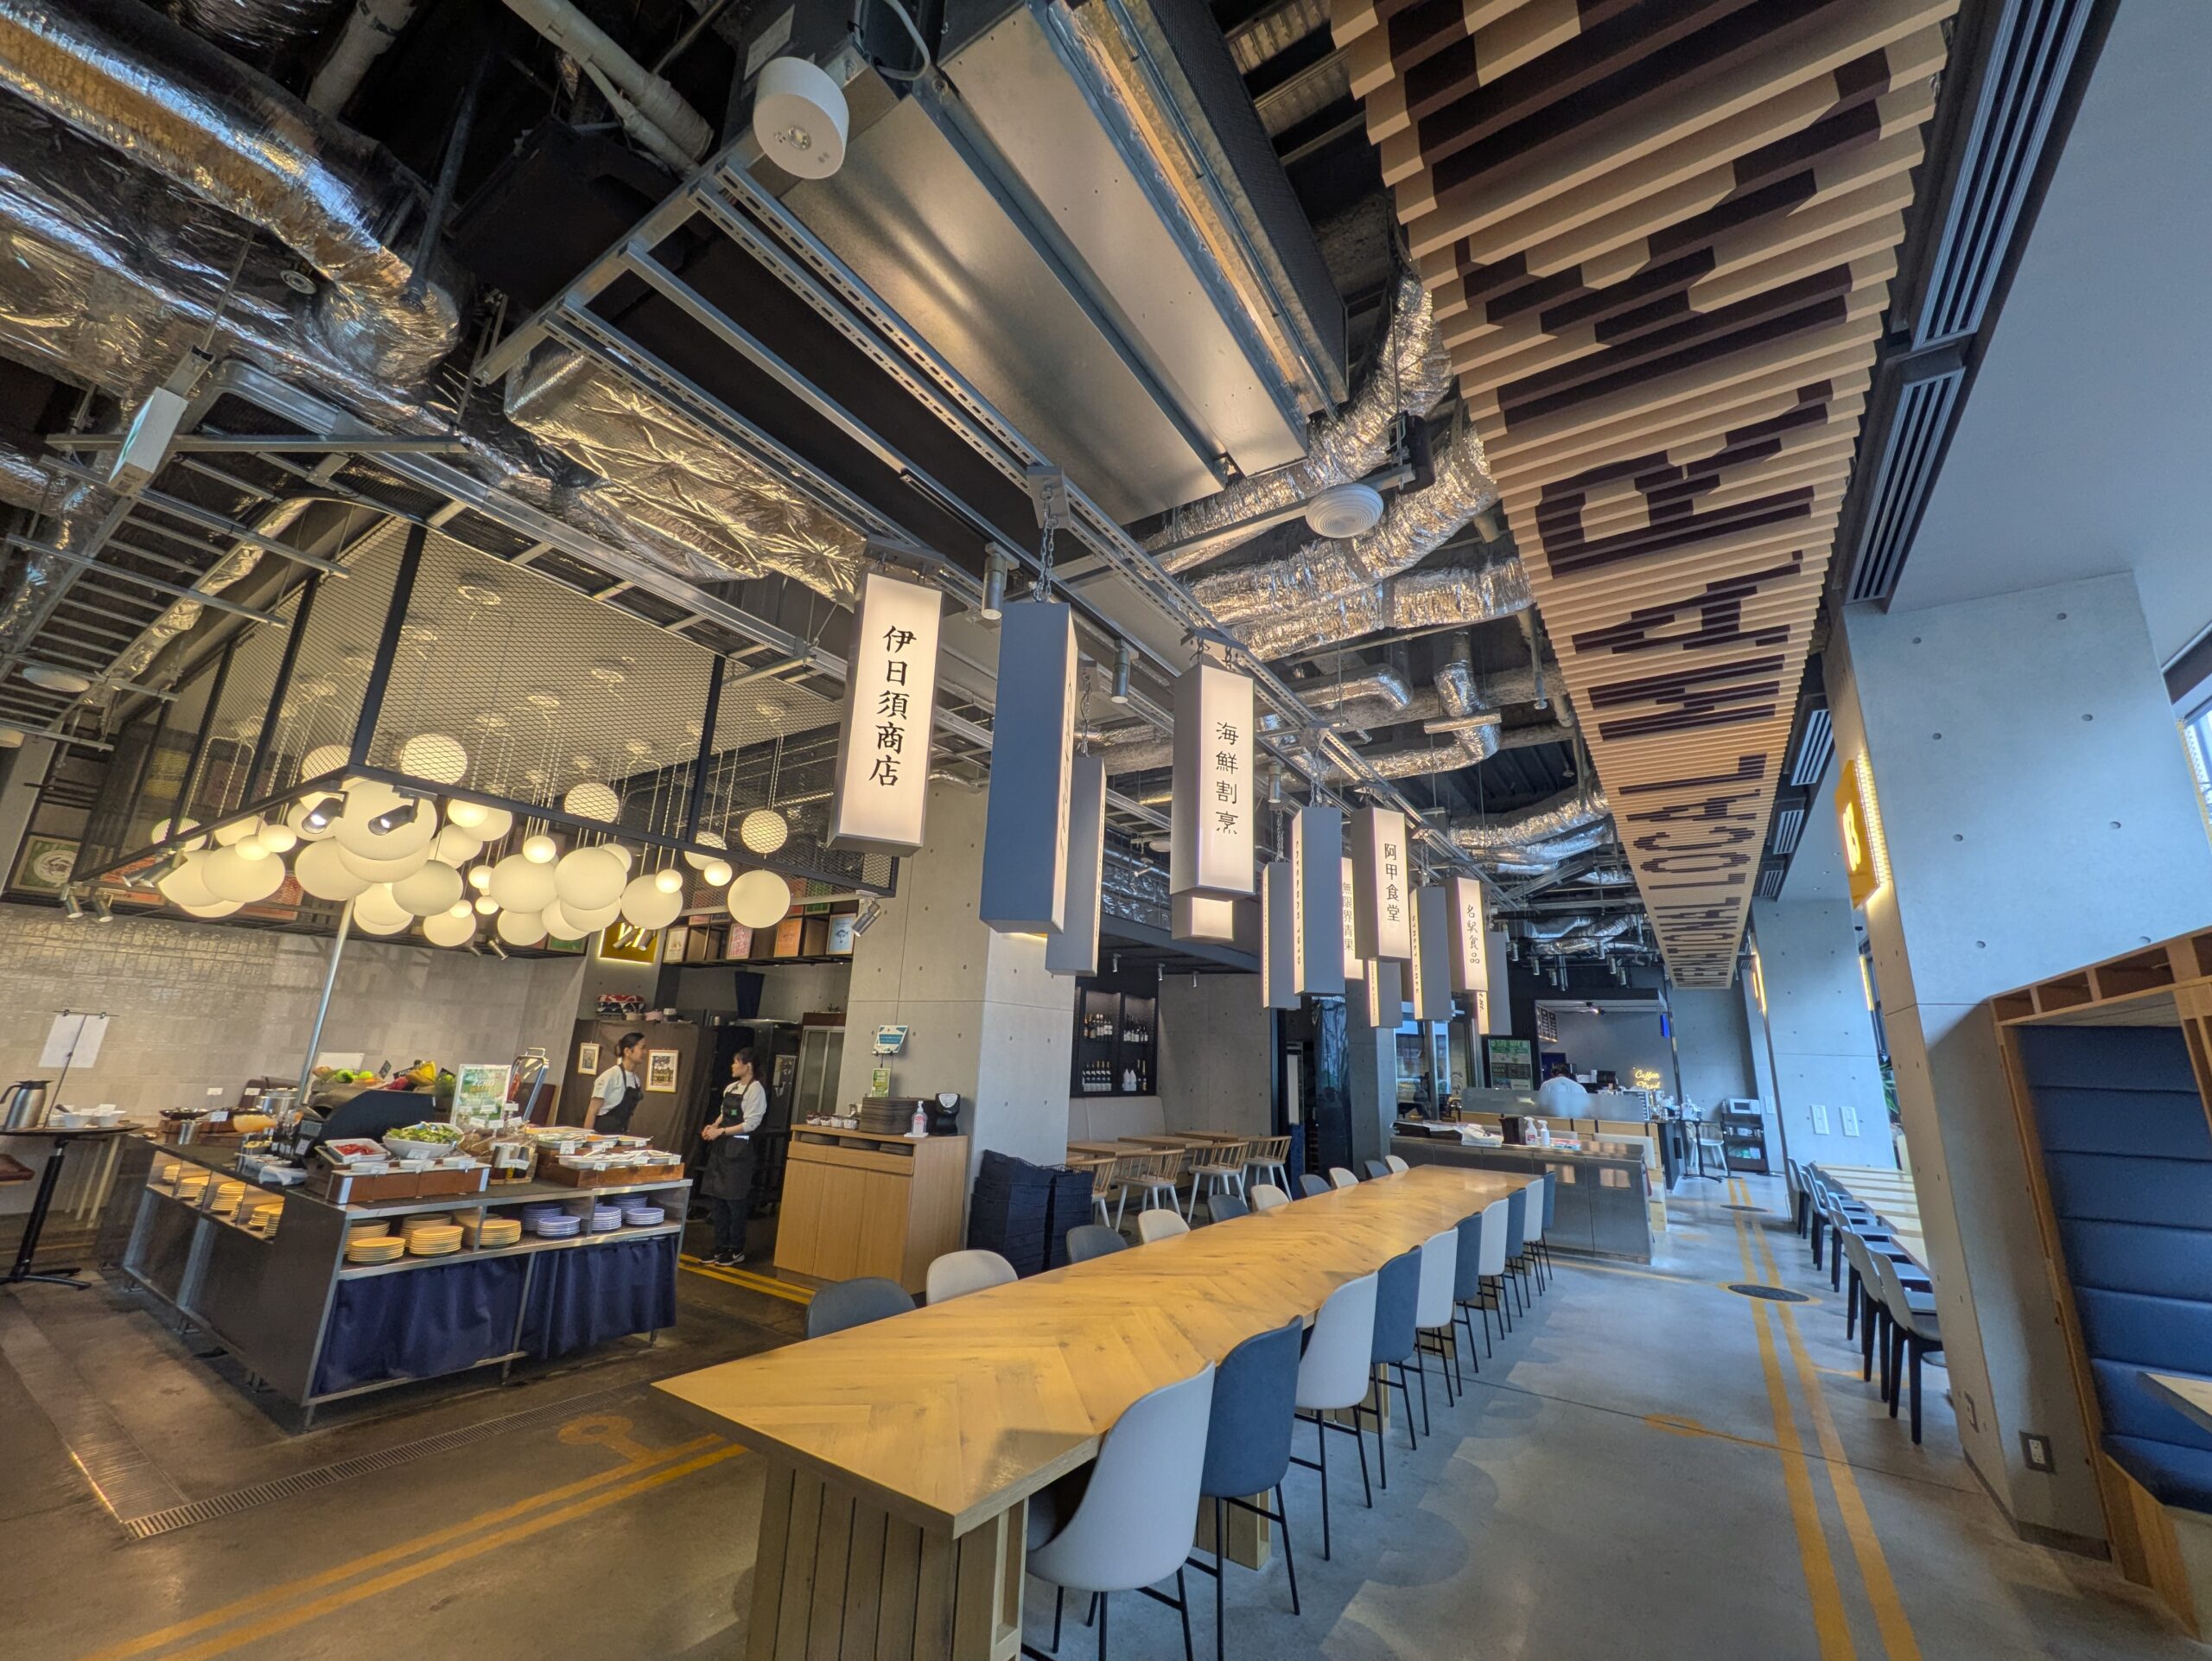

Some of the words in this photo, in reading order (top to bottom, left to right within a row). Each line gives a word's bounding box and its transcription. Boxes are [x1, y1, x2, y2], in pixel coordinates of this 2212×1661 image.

[868, 625, 918, 786] 伊日須商店
[1215, 721, 1239, 835] 海鮮割烹
[1618, 753, 1767, 890] LOCAL
[1342, 882, 1354, 951] 無限界青果
[1384, 843, 1400, 922] 阿甲食堂
[1654, 896, 1742, 987] INTERNATIONAL
[1635, 1069, 1660, 1081] Coffee
